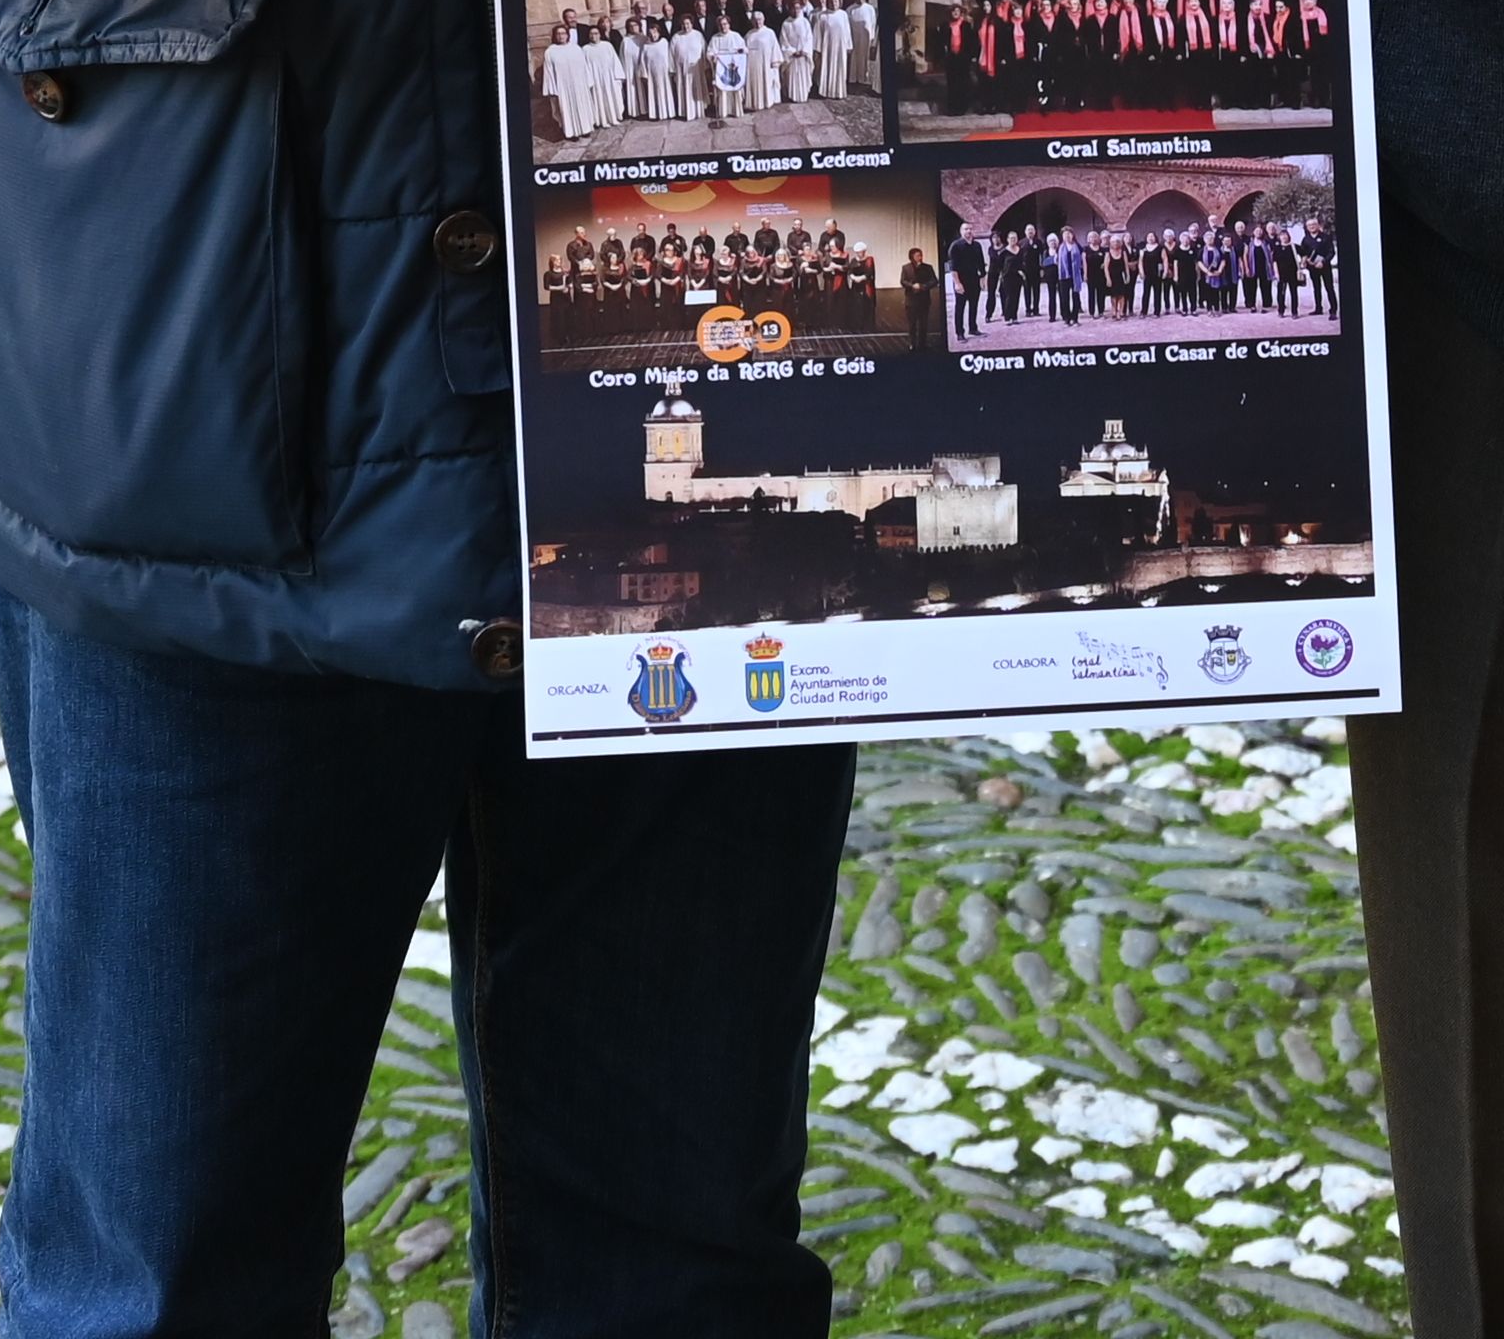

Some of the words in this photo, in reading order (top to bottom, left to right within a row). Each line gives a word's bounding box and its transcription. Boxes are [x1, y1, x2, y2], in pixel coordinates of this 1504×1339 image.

[1047, 140, 1098, 158] Coral
[1107, 136, 1211, 156] Salmantina
[535, 165, 585, 185] Coral
[595, 160, 718, 180] Mirobrigense
[960, 354, 1025, 374] Cynara
[1105, 346, 1156, 364] Coral
[1165, 345, 1216, 362] Casar
[1225, 342, 1247, 359] de
[1257, 341, 1329, 358] Cáceres
[590, 370, 636, 387] Coro
[645, 367, 696, 384] Misto
[707, 364, 729, 381] da
[802, 359, 824, 376] de
[833, 357, 874, 374] Góis
[790, 677, 869, 692] Ayuntamiento
[872, 675, 887, 686] de
[790, 692, 834, 704] Ciudad
[839, 690, 888, 704] Rodrigo
